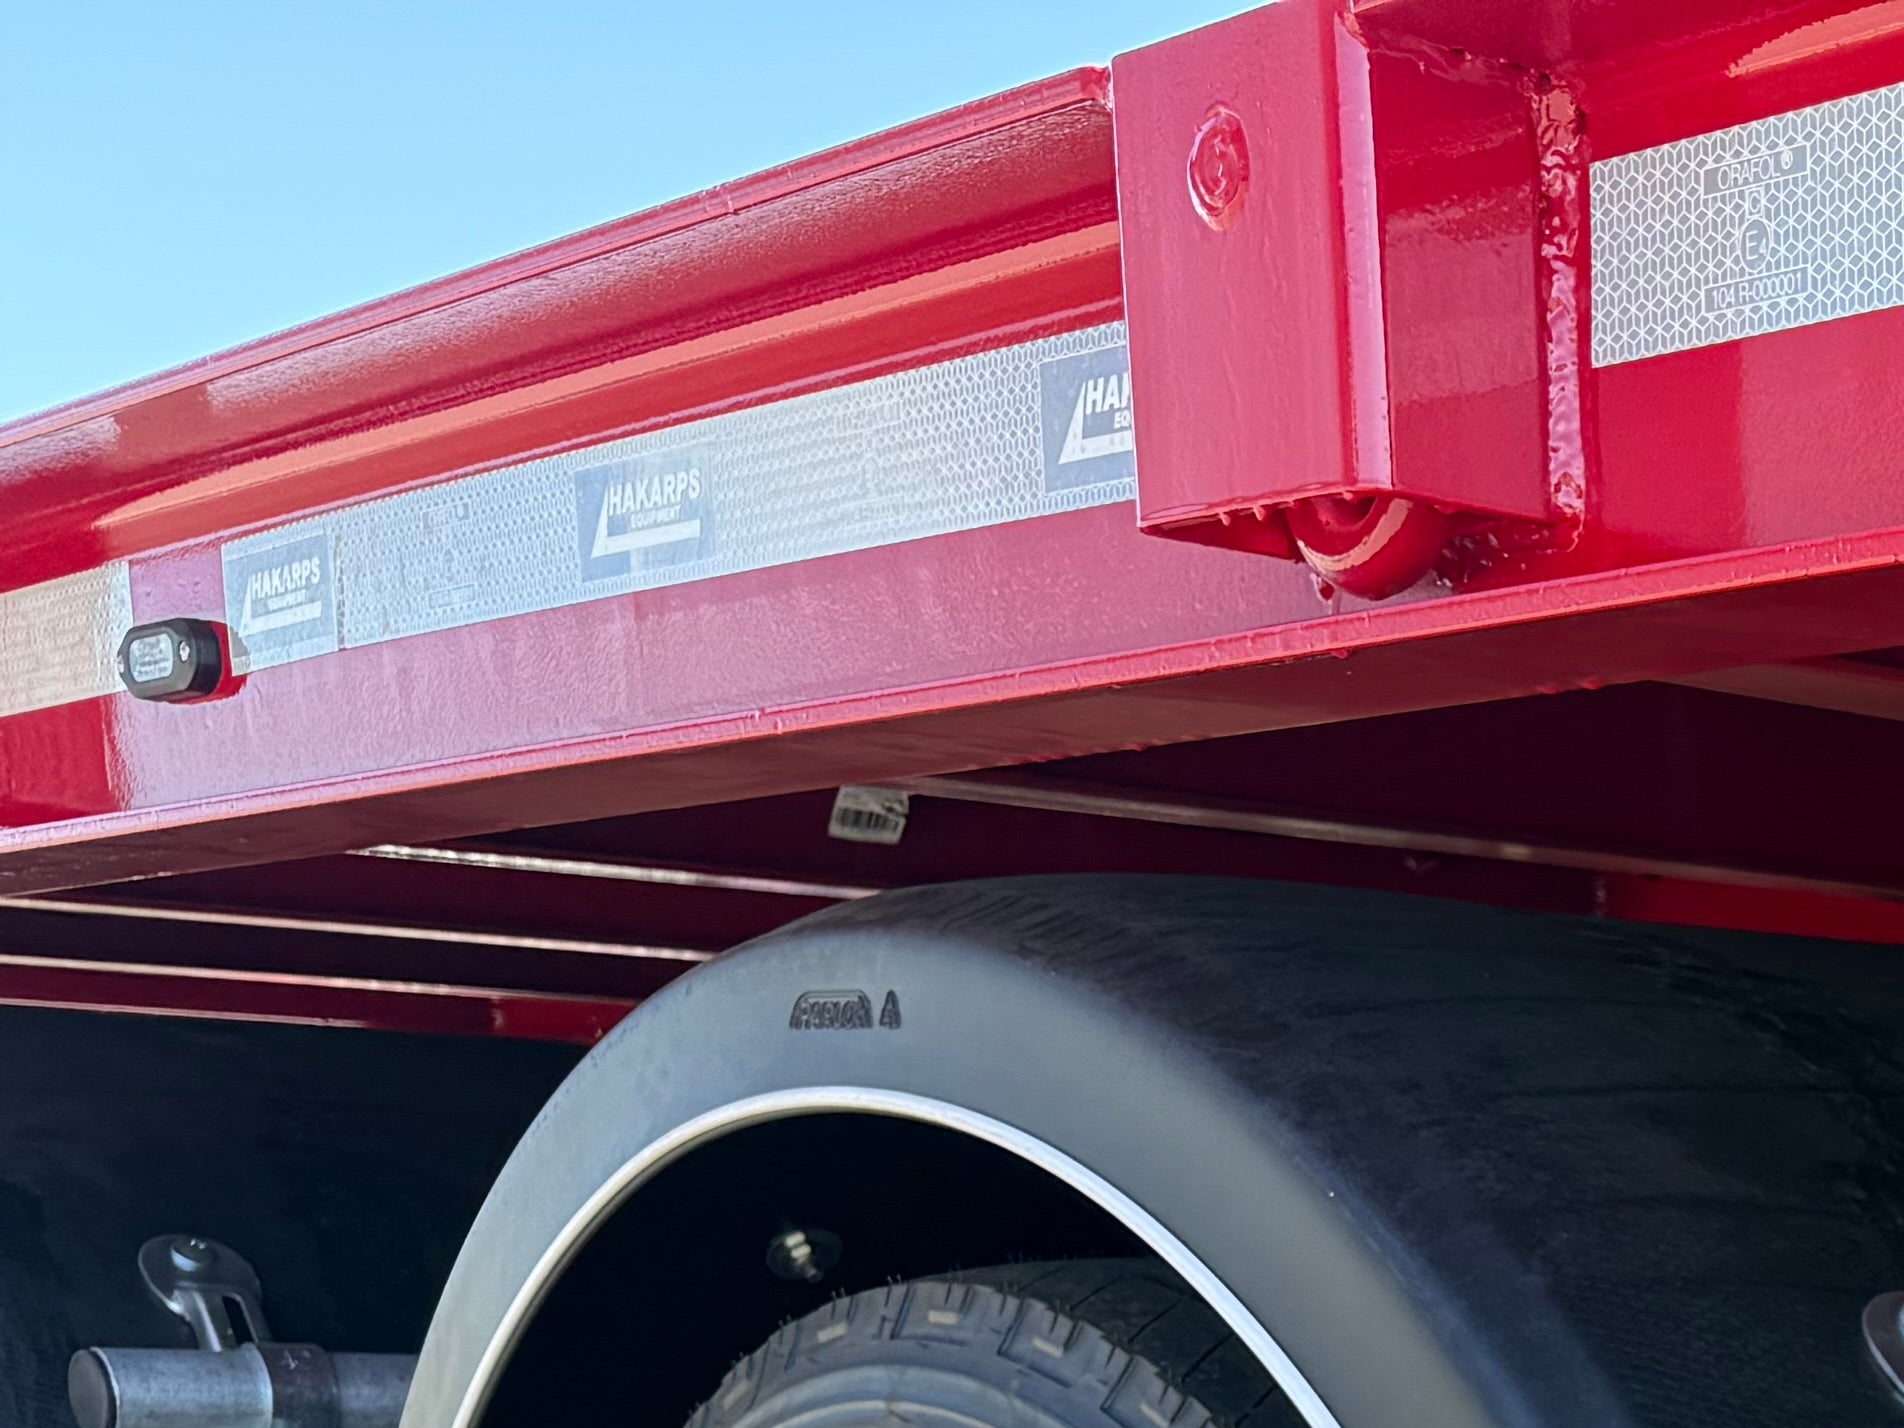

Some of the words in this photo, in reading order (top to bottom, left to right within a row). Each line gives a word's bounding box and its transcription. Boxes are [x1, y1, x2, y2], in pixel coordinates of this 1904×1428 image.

[1712, 286, 1735, 310] 104
[608, 468, 701, 516] HAKARPS
[252, 556, 320, 599] HAKARPS
